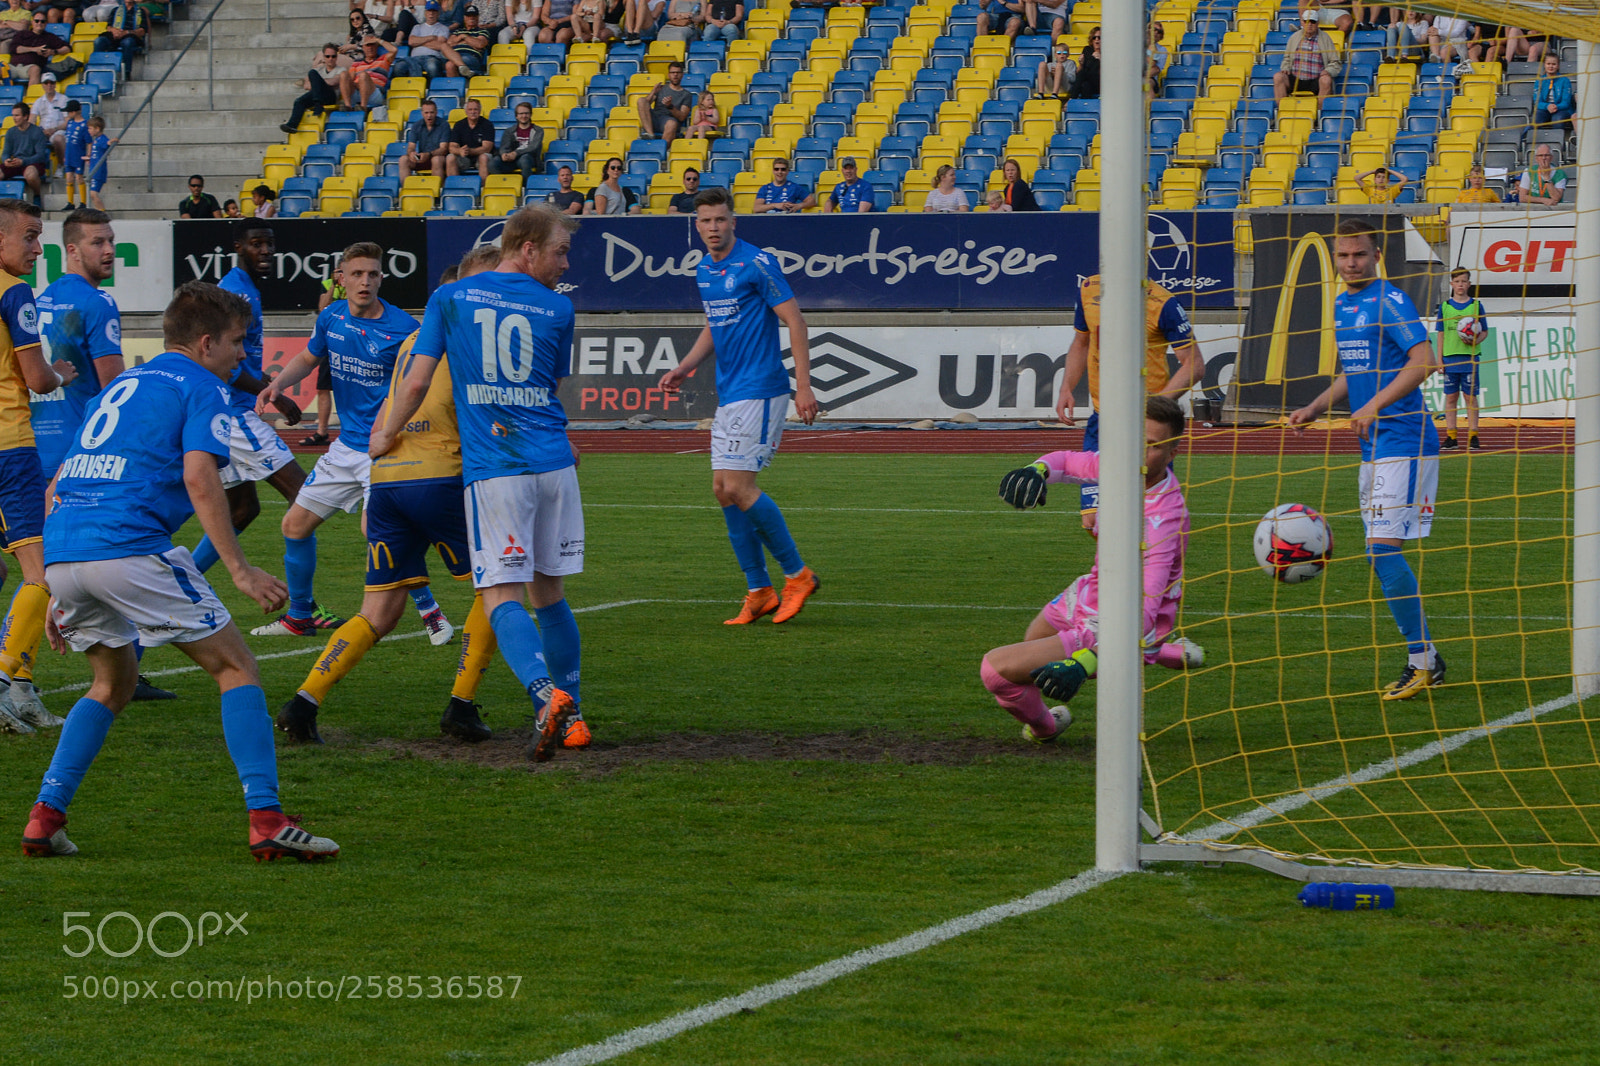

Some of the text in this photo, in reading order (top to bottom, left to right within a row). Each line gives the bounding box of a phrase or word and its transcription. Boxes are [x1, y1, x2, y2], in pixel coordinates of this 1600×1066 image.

[601, 227, 1057, 286] Due portsreiser
[473, 307, 534, 384] 10
[1502, 329, 1539, 364] WE
[342, 363, 384, 378] ENERGI
[81, 377, 140, 450] 8
[580, 387, 680, 411] PROFF
[1372, 503, 1384, 519] 14
